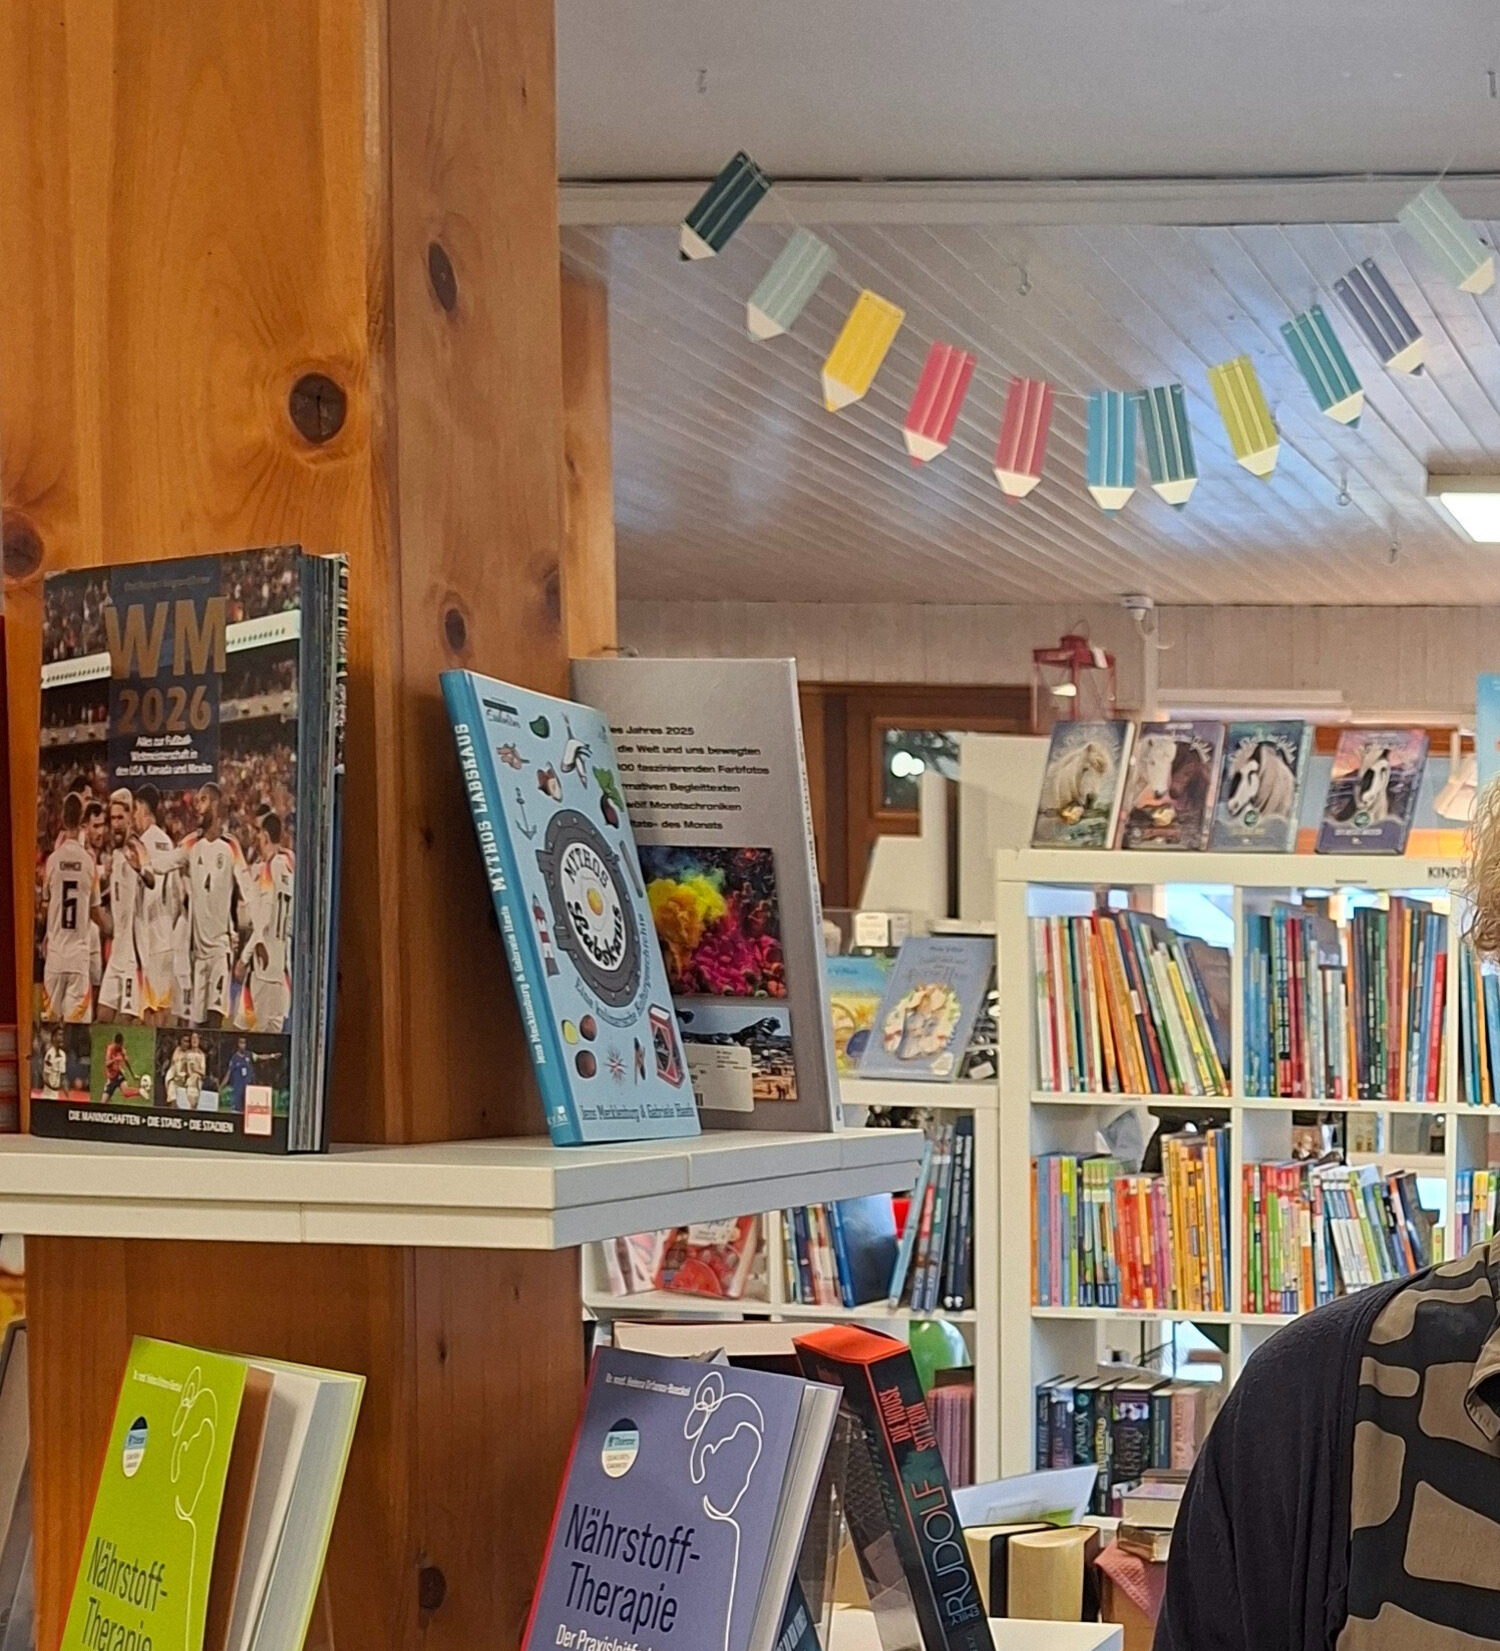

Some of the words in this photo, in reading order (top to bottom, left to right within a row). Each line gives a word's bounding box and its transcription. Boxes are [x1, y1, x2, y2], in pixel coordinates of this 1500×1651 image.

[104, 593, 229, 679] WM
[117, 685, 211, 733] 2026
[618, 745, 633, 753] die
[637, 745, 659, 754] Welt
[663, 746, 682, 754] und
[708, 746, 761, 757] bewegten
[626, 726, 662, 735] Jahres
[666, 727, 694, 735] 2025
[454, 723, 488, 814] LABSKAUS
[638, 764, 715, 774] faszinierenden
[718, 765, 770, 774] Farbfotos
[670, 783, 740, 793] Begleittexten
[650, 801, 742, 811] Monatschroniken
[661, 820, 681, 829] des
[683, 820, 723, 830] Monats
[477, 820, 507, 893] MYTHOS
[564, 847, 609, 888] MYTHOS
[204, 873, 212, 893] 4
[61, 880, 78, 930] 6
[216, 974, 224, 994] 4
[891, 1426, 912, 1444] DIE
[906, 1401, 937, 1451] SITTERIN
[564, 1503, 700, 1575] Nährstoff-
[910, 1479, 978, 1617] RUDOLF
[86, 1536, 168, 1613] Nährstoff-
[566, 1561, 678, 1635] Therapie
[556, 1624, 576, 1648] Der
